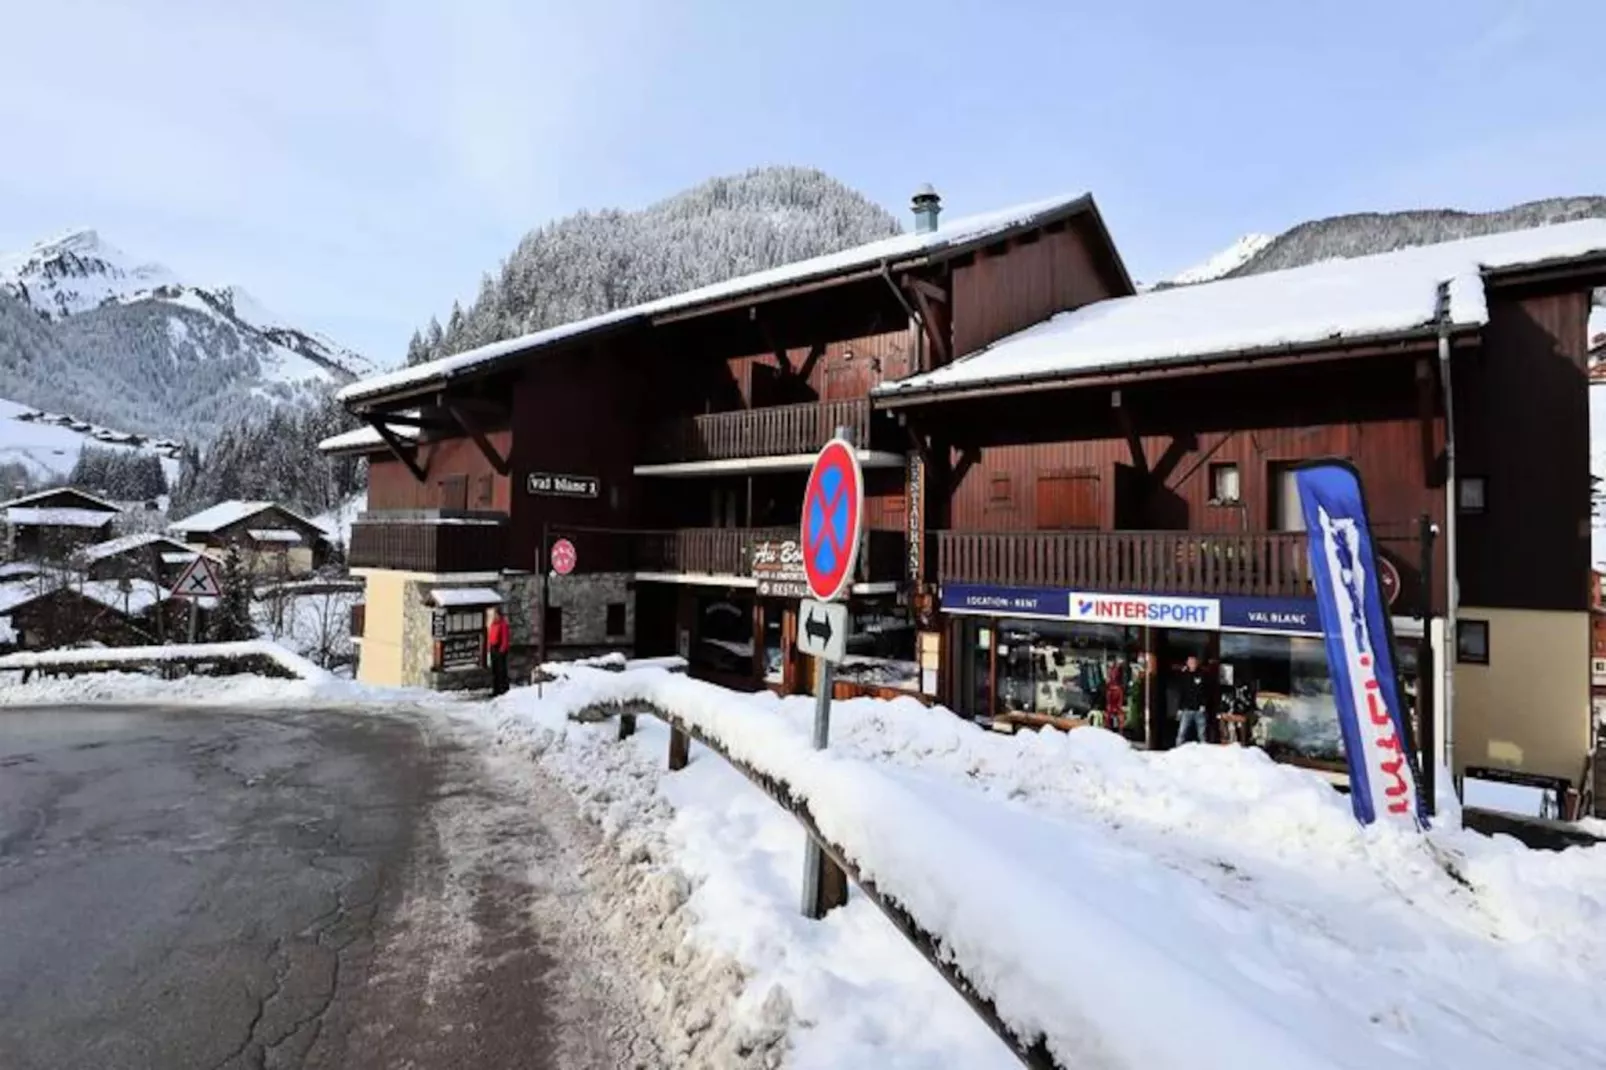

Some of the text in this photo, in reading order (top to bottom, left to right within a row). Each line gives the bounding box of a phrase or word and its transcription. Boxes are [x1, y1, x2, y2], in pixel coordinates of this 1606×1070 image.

[1014, 598, 1038, 608] RENT
[1095, 600, 1209, 622] INTERSPORT
[1247, 611, 1307, 626] VAL BLANC
